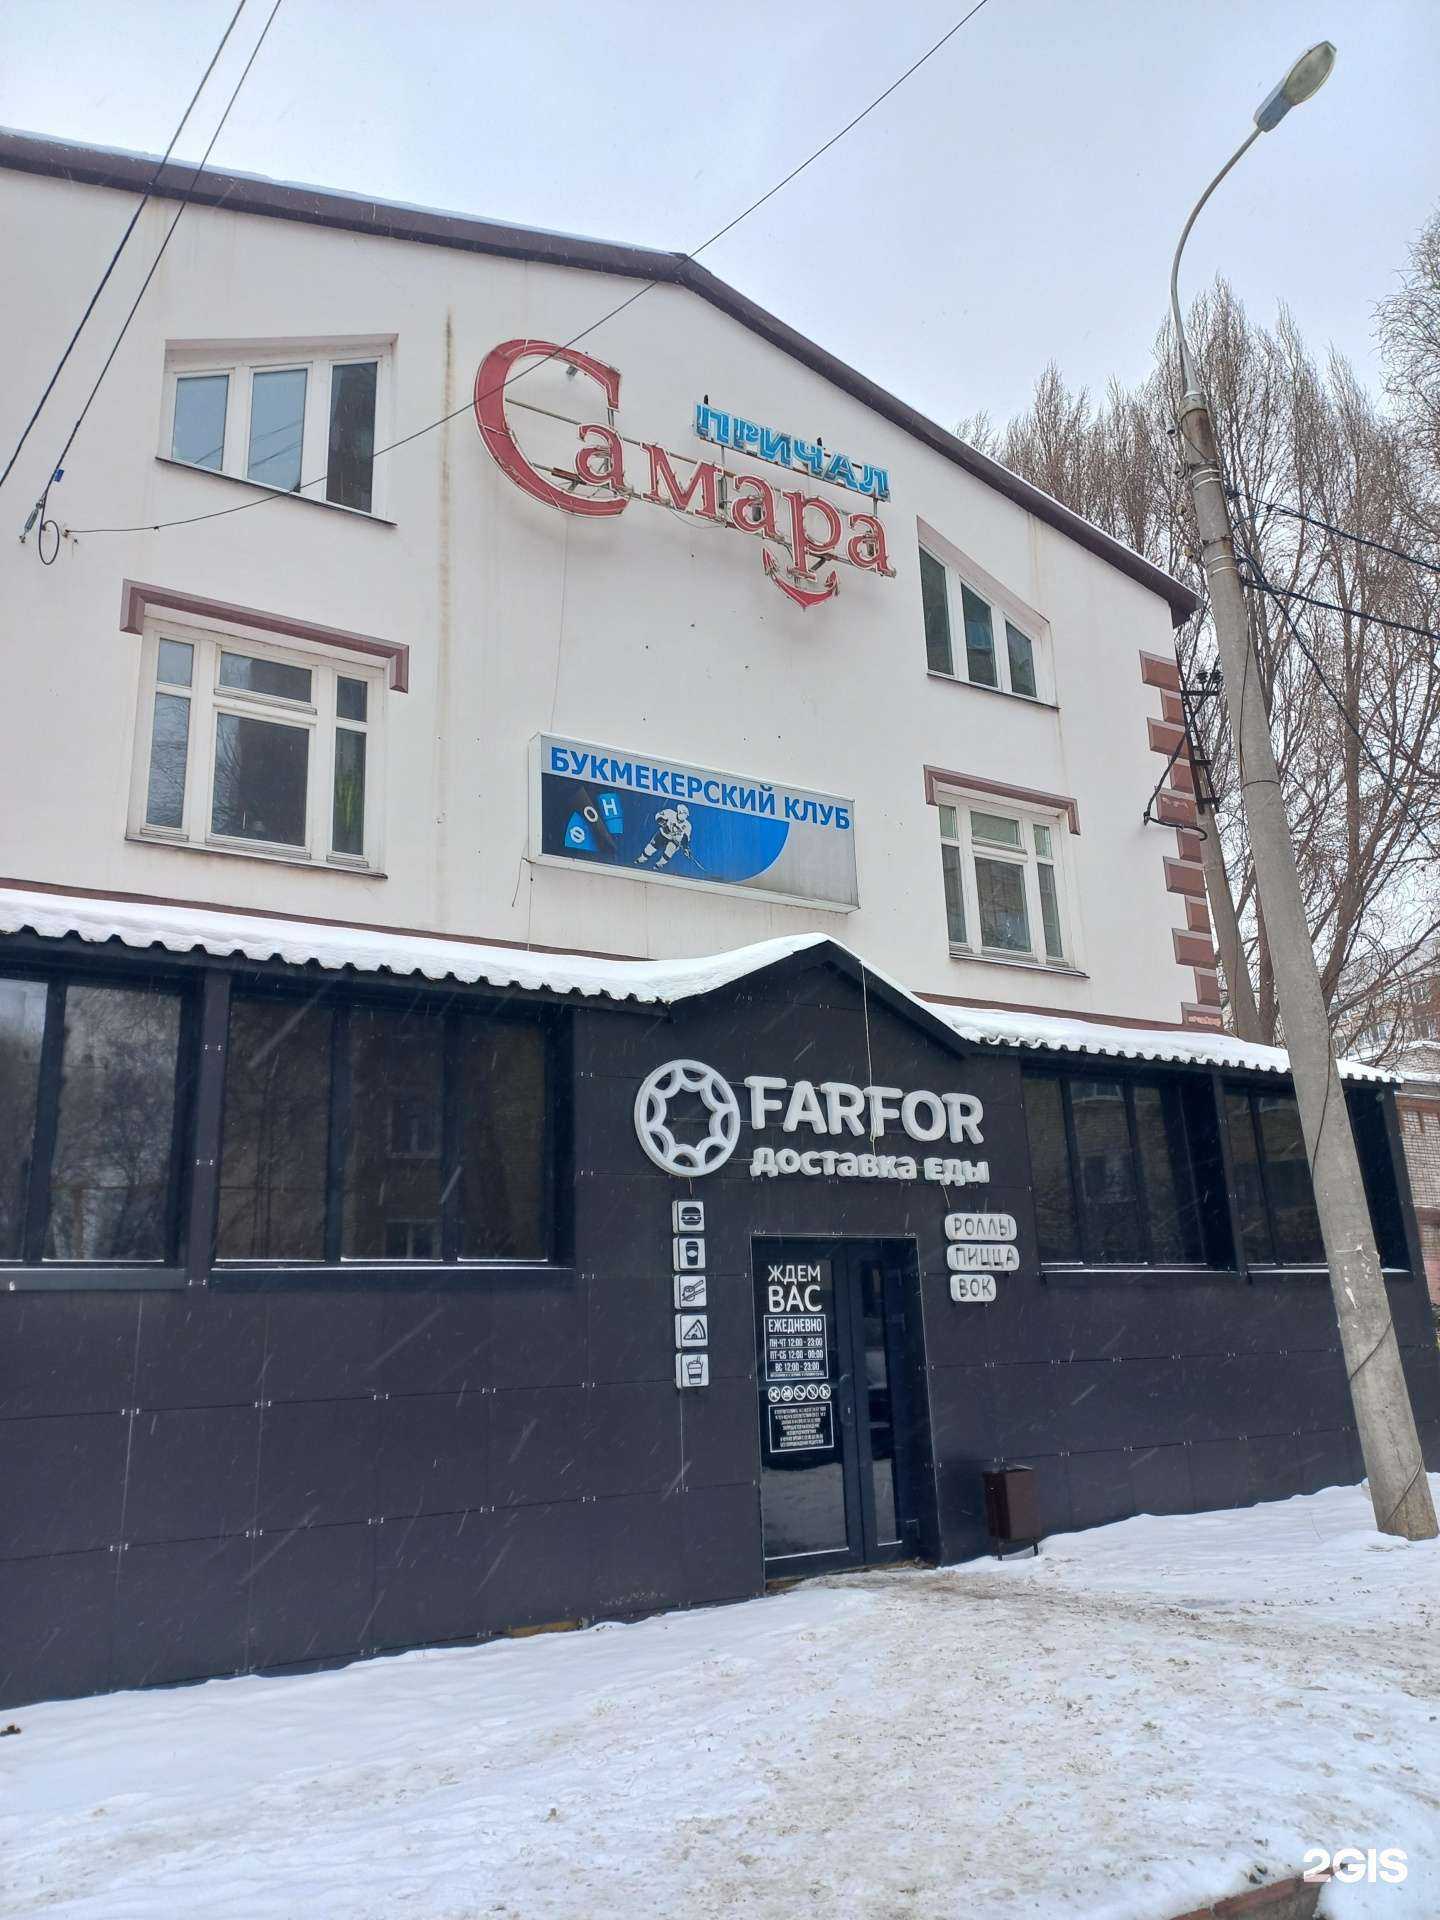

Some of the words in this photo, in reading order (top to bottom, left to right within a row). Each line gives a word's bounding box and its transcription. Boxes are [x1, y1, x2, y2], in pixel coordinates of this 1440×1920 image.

[473, 338, 896, 580] Самара
[693, 401, 891, 503] ПРИЧАЛ
[551, 746, 776, 815] БУКМЕКЕРСКИЙ
[784, 796, 850, 830] КЛУБ
[744, 1076, 984, 1144] FARFOR
[954, 1217, 1012, 1236] РОЛЛЫ
[956, 1247, 1016, 1269] ПИЦЦА
[767, 1265, 821, 1285] ЖДЕМ
[767, 1285, 823, 1313] ВАС
[959, 1278, 992, 1298] ВОК
[768, 1318, 822, 1333] ЕЖЕДНЕВНО
